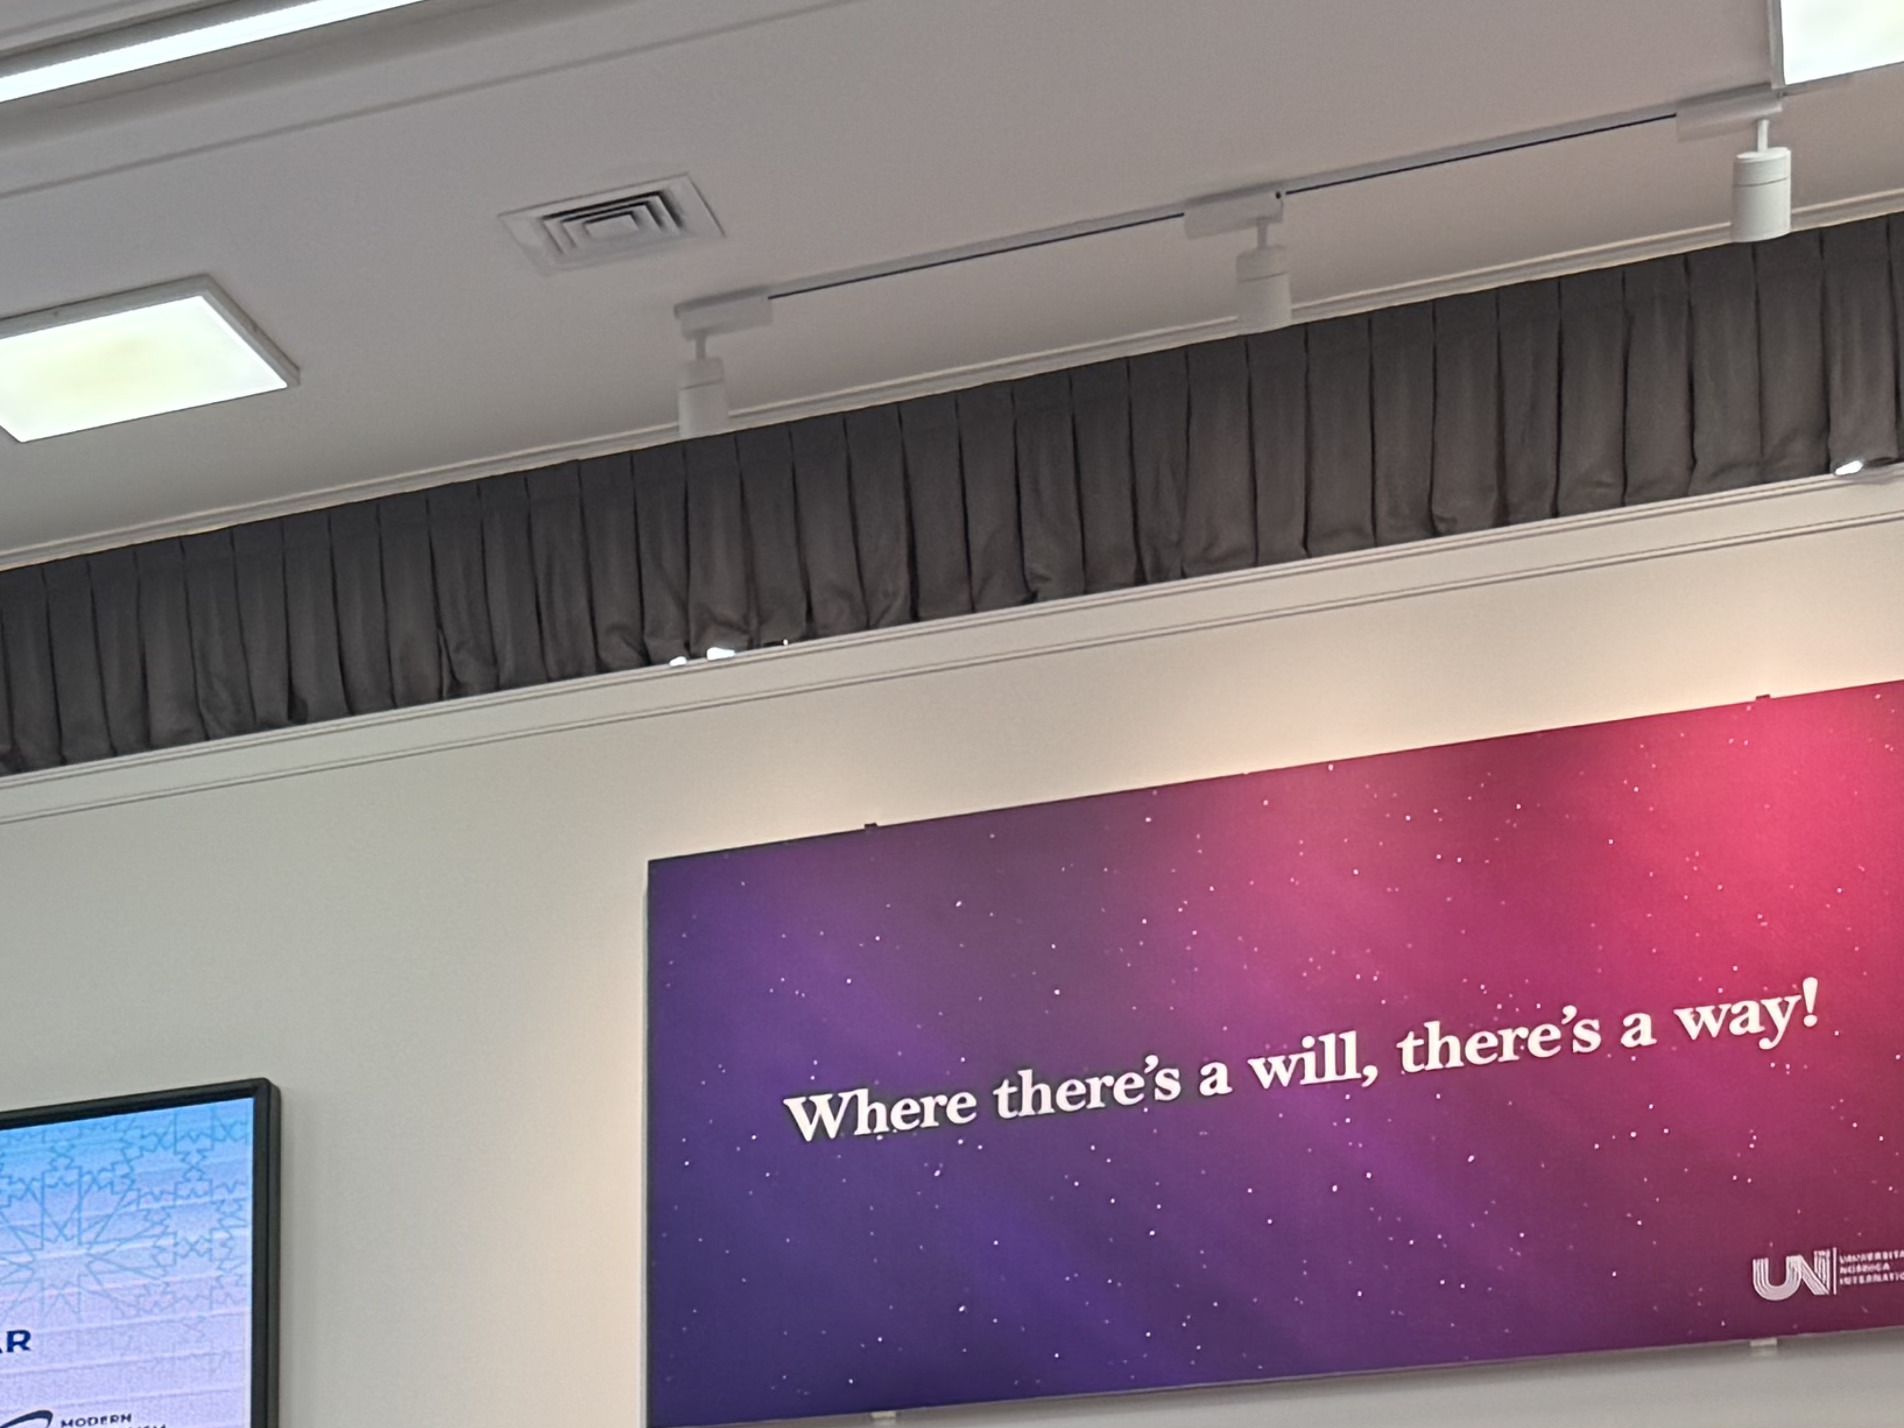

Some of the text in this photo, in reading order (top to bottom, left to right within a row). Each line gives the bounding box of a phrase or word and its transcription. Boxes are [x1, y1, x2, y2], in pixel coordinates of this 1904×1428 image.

[785, 1086, 978, 1144] Where
[1198, 1060, 1232, 1097] a
[1248, 1030, 1379, 1094] will,
[1620, 1011, 1657, 1049] a
[1673, 976, 1821, 1060] way!
[59, 1412, 133, 1428] MODERN
